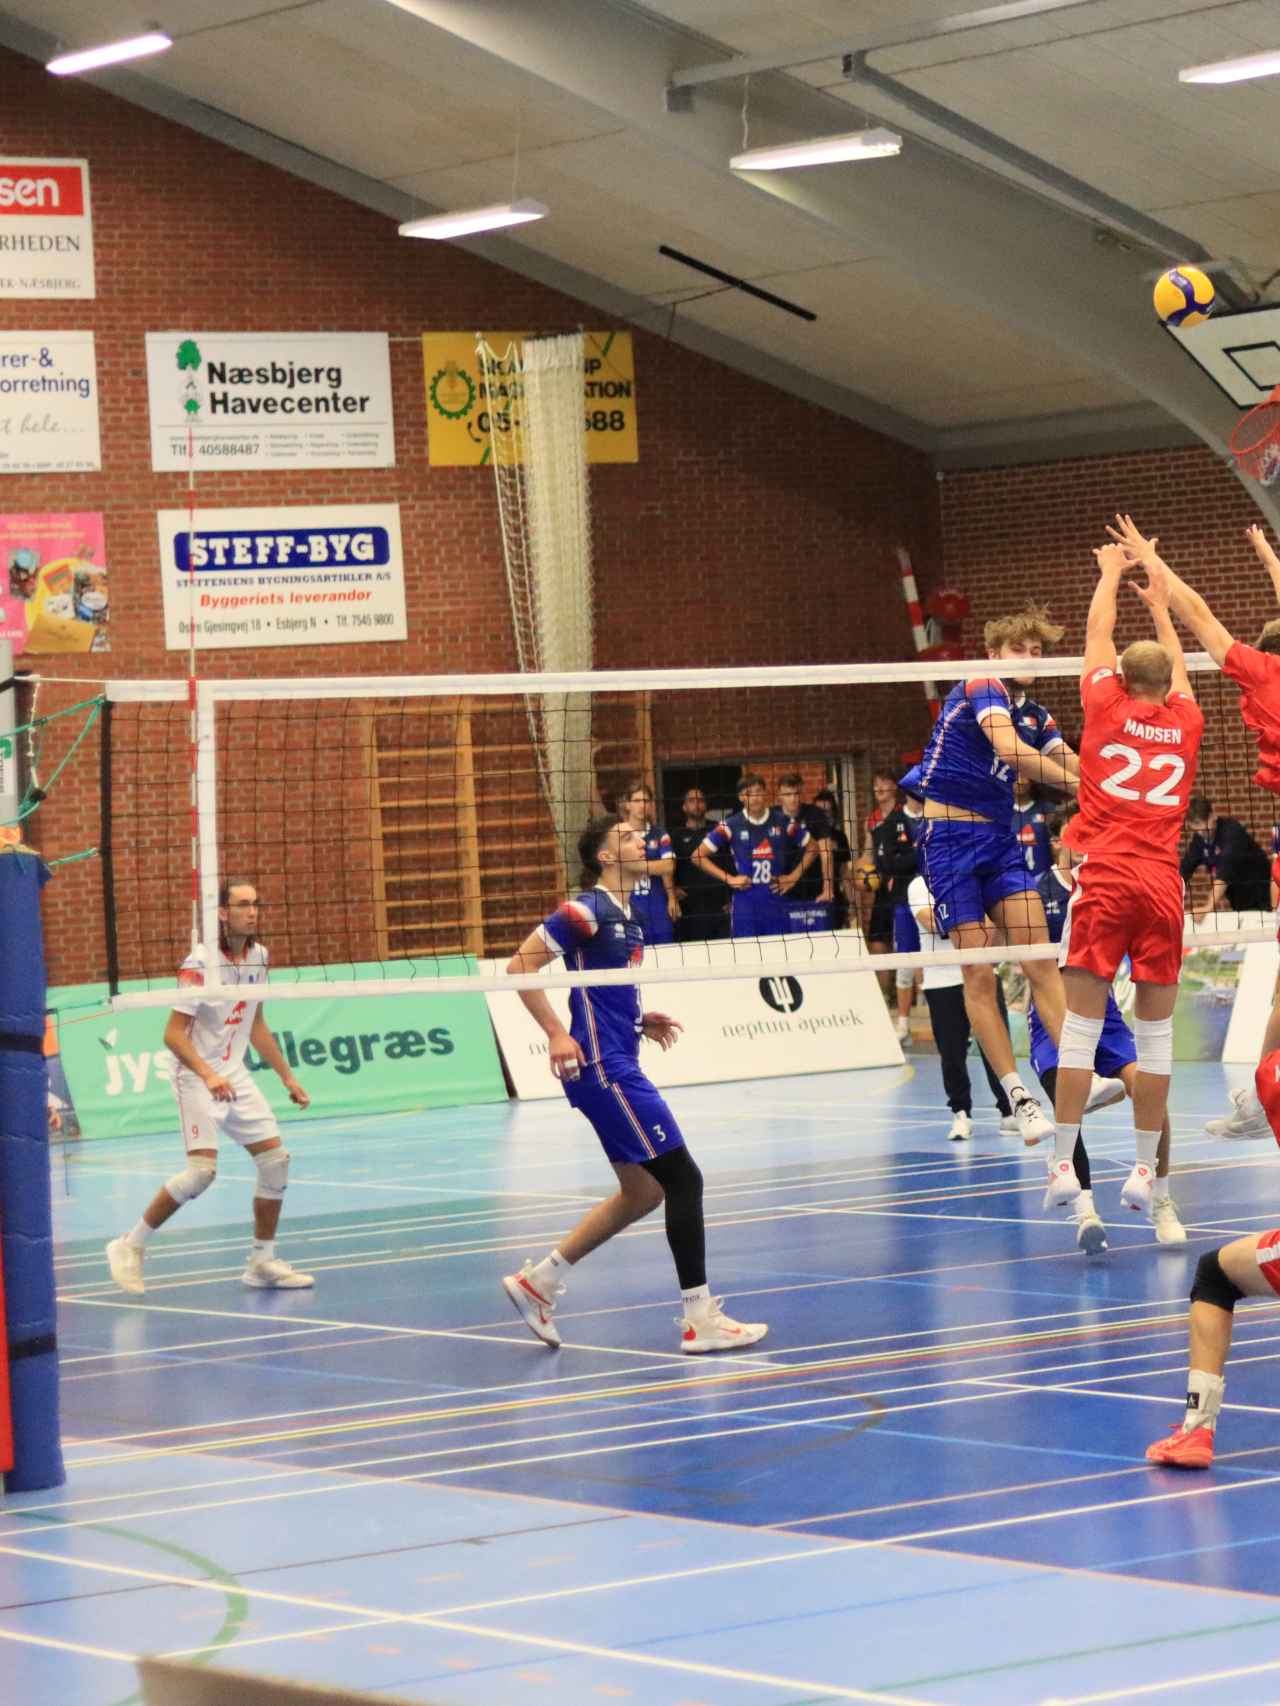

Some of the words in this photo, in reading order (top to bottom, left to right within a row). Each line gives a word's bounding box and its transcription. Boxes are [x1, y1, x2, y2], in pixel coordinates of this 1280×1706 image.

[207, 361, 342, 388] Næsbjerg
[210, 391, 370, 414] Havecenter
[190, 533, 375, 567] STEFF-BYG
[200, 592, 284, 608] Byggeriets
[1123, 718, 1181, 744] MADSEN
[1099, 743, 1185, 806] 22
[752, 859, 771, 884] 28
[721, 1019, 791, 1040] neptun
[798, 1009, 865, 1034] apotek
[653, 1124, 667, 1142] 3
